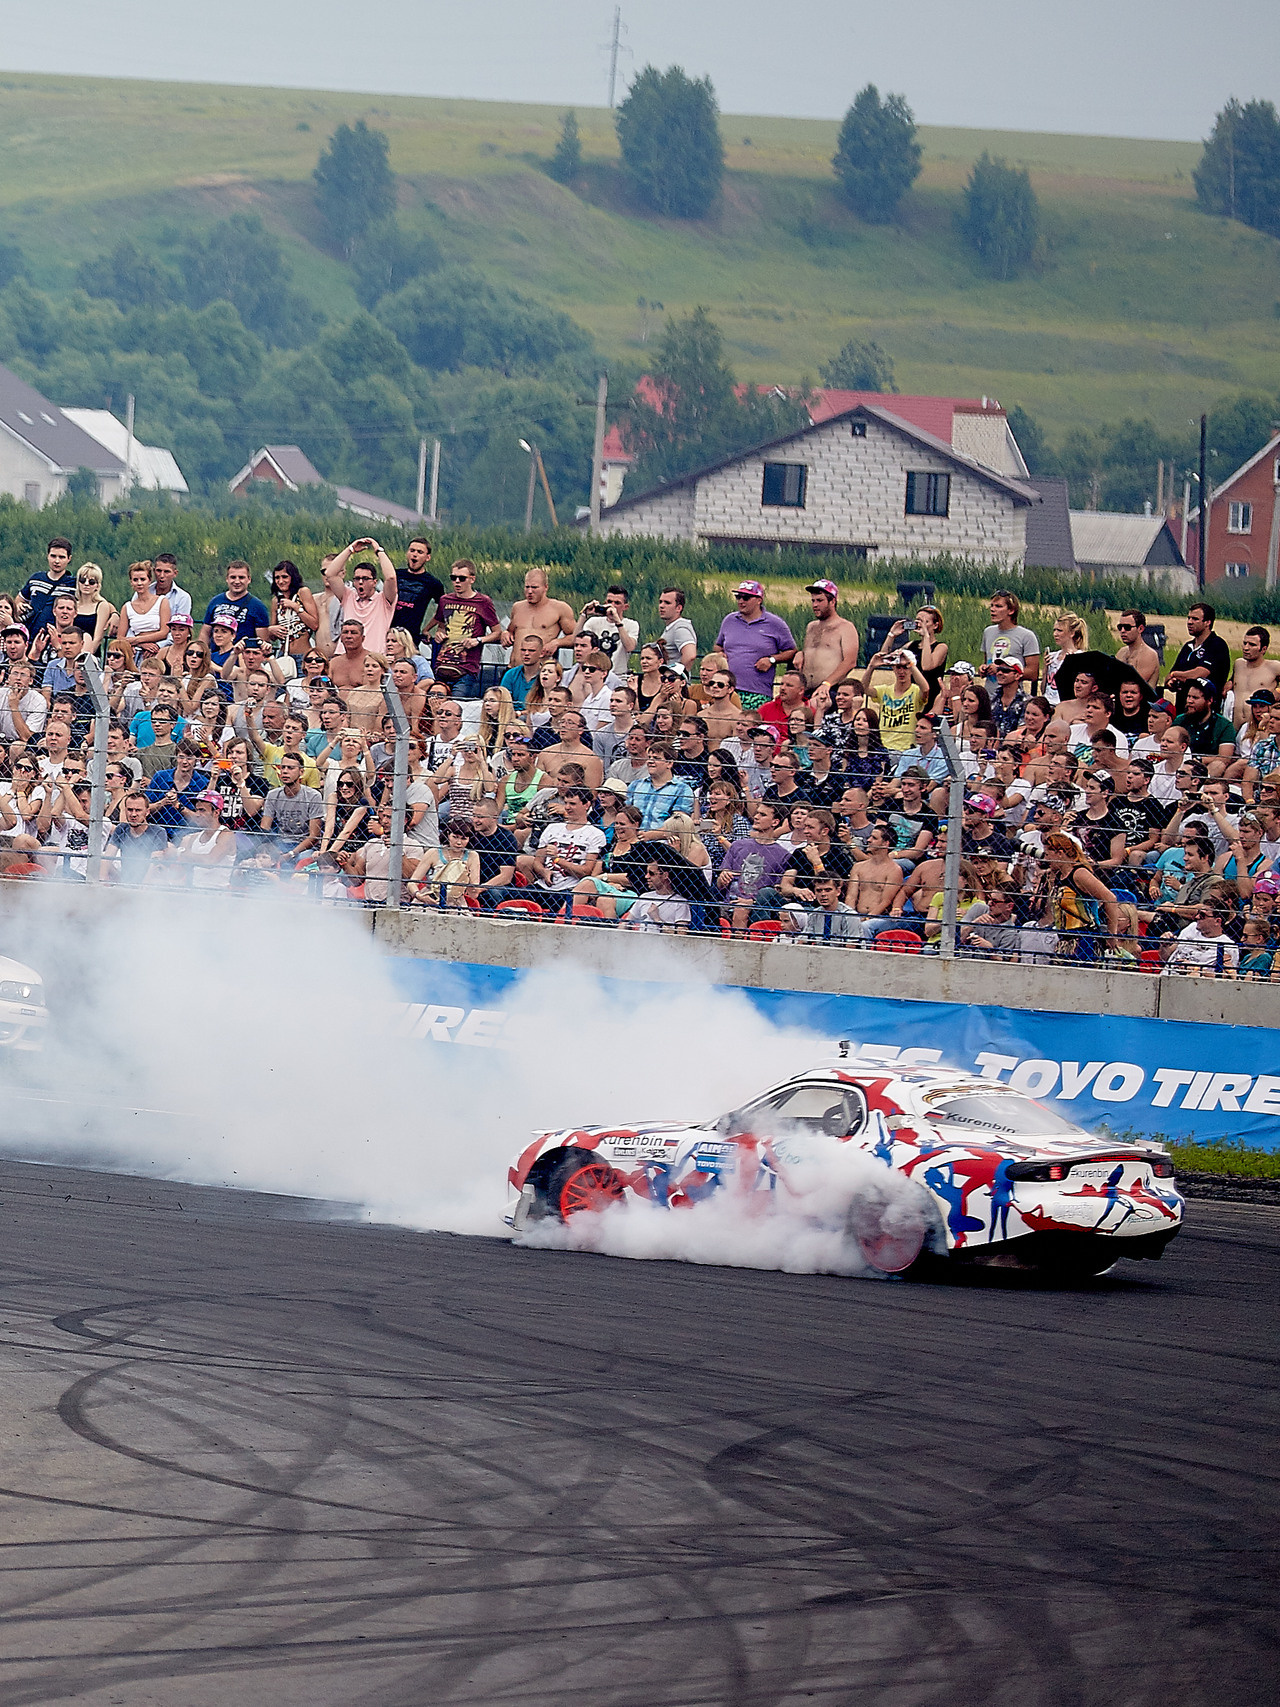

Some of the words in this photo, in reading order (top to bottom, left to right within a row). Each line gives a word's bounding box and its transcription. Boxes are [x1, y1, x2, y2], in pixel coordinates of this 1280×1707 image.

[882, 704, 897, 717] ALL
[898, 702, 915, 714] THE
[883, 714, 910, 728] TIME
[974, 1051, 1145, 1102] TOYO
[946, 1111, 1017, 1135] Kurenbin
[1070, 1168, 1109, 1178] #kurenbin
